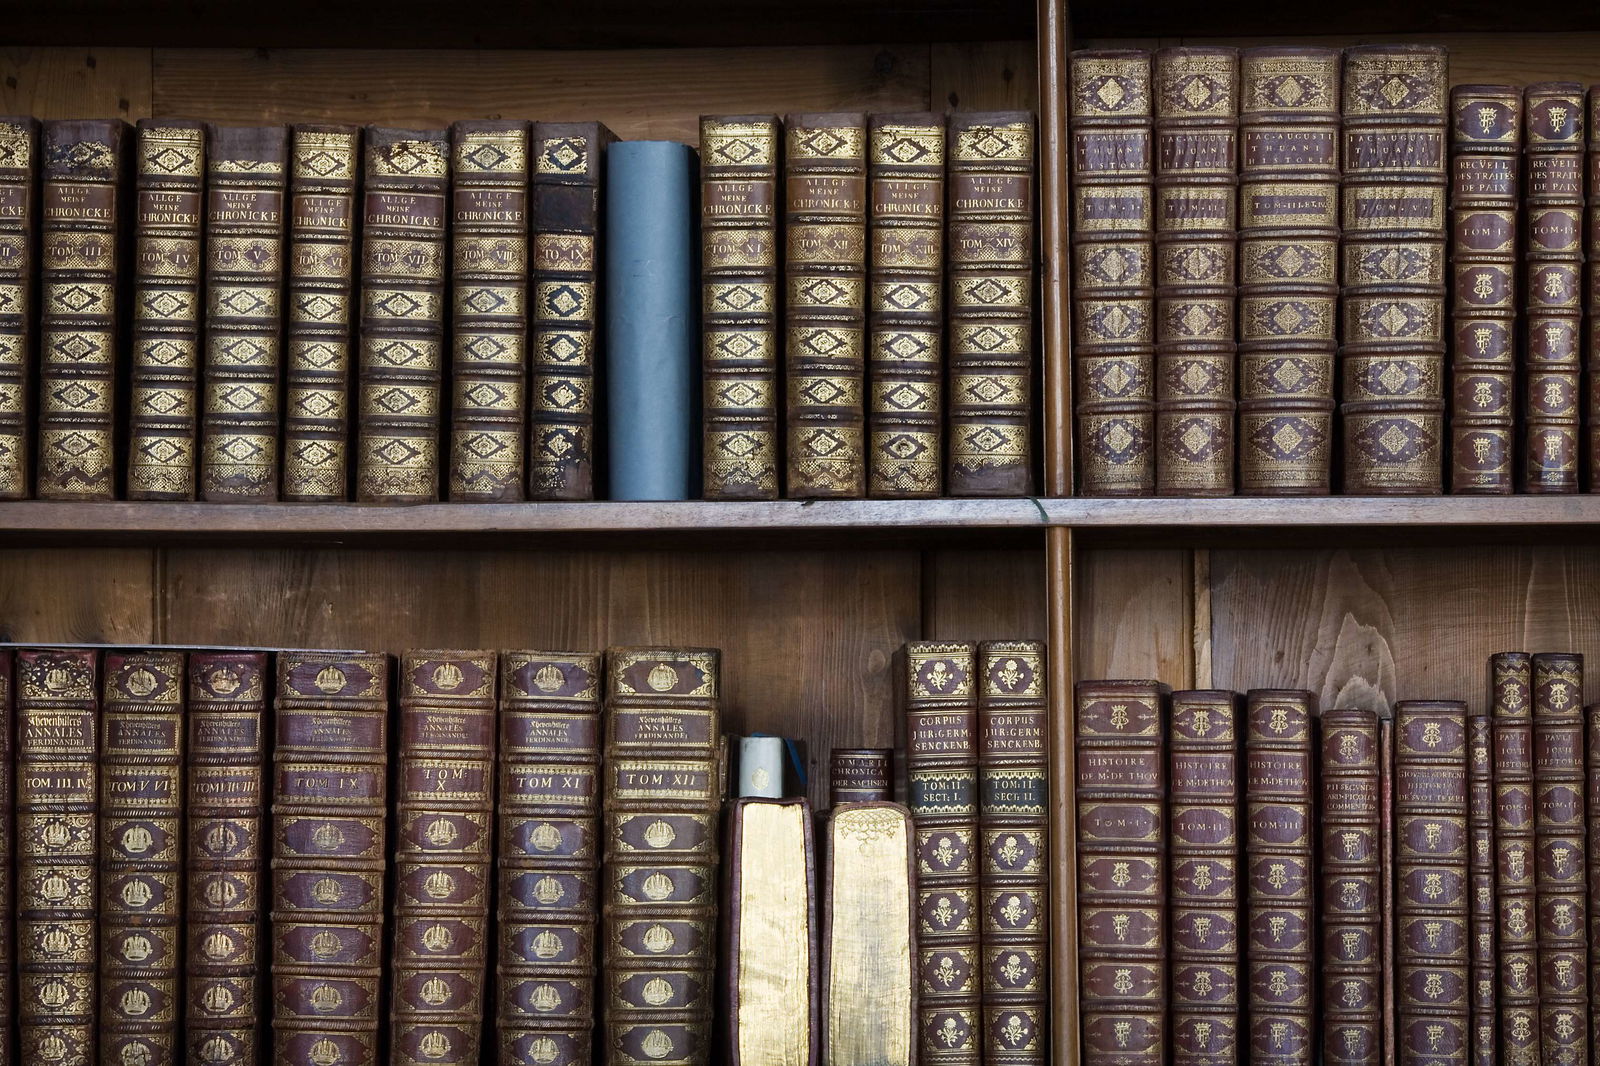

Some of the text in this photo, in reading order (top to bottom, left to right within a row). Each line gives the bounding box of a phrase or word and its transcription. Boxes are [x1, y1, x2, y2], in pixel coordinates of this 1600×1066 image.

[1080, 146, 1142, 155] THUANI
[1165, 147, 1226, 155] THUANI
[1355, 146, 1425, 154] THUANI
[806, 178, 848, 187] ALLGE
[971, 177, 1013, 185] ALLGE
[58, 187, 91, 195] ALLGE
[717, 184, 753, 192] ALLGE
[886, 183, 929, 191] ALLGE
[974, 185, 1003, 193] MEINE
[1462, 184, 1508, 192] DE PAIX
[1534, 183, 1578, 191] DE PAIX
[148, 194, 182, 203] ALLGE
[222, 193, 257, 202] ALLGE
[381, 195, 416, 204] ALLGE
[470, 192, 512, 200] ALLGE
[153, 203, 179, 211] MEINE
[303, 198, 342, 207] ALLGE
[475, 200, 503, 208] MEINE
[793, 199, 860, 209] CHRONICKE
[956, 198, 1024, 209] CHRONICKE
[44, 207, 110, 218] CHRONICKE
[307, 206, 335, 214] MEINE
[386, 205, 410, 213] MEINE
[703, 204, 772, 215] CHRONICKE
[875, 203, 940, 214] CHRONICKE
[139, 212, 198, 223] CHRONICKE
[209, 210, 278, 221] CHRONICKE
[368, 214, 440, 226] CHRONICKE
[457, 210, 521, 221] CHRONICKE
[801, 238, 821, 249] TOM
[961, 239, 983, 249] TOM
[51, 246, 74, 256] TOM
[712, 244, 736, 253] TOM
[881, 244, 901, 253] TOM
[142, 252, 164, 262] TOM
[217, 250, 240, 260] TOM
[377, 252, 398, 262] TOM
[465, 251, 484, 260] TOM
[570, 249, 584, 260] IX
[299, 255, 318, 265] TOM
[920, 716, 962, 726] CORPUS
[990, 716, 1034, 725] CORPUS
[637, 724, 684, 732] ANNALES
[25, 728, 83, 738] ANNALES
[1088, 758, 1145, 766] HISTOIRE
[1175, 762, 1228, 770] HISTOIRE
[1250, 761, 1301, 770] HISTOIRE
[672, 774, 696, 785] XII
[1081, 772, 1093, 780] DE
[154, 780, 168, 791] VI
[295, 777, 359, 788] TOM IX
[436, 780, 446, 791] X
[517, 777, 579, 788] TOM XI
[851, 779, 888, 787] SACHSEN
